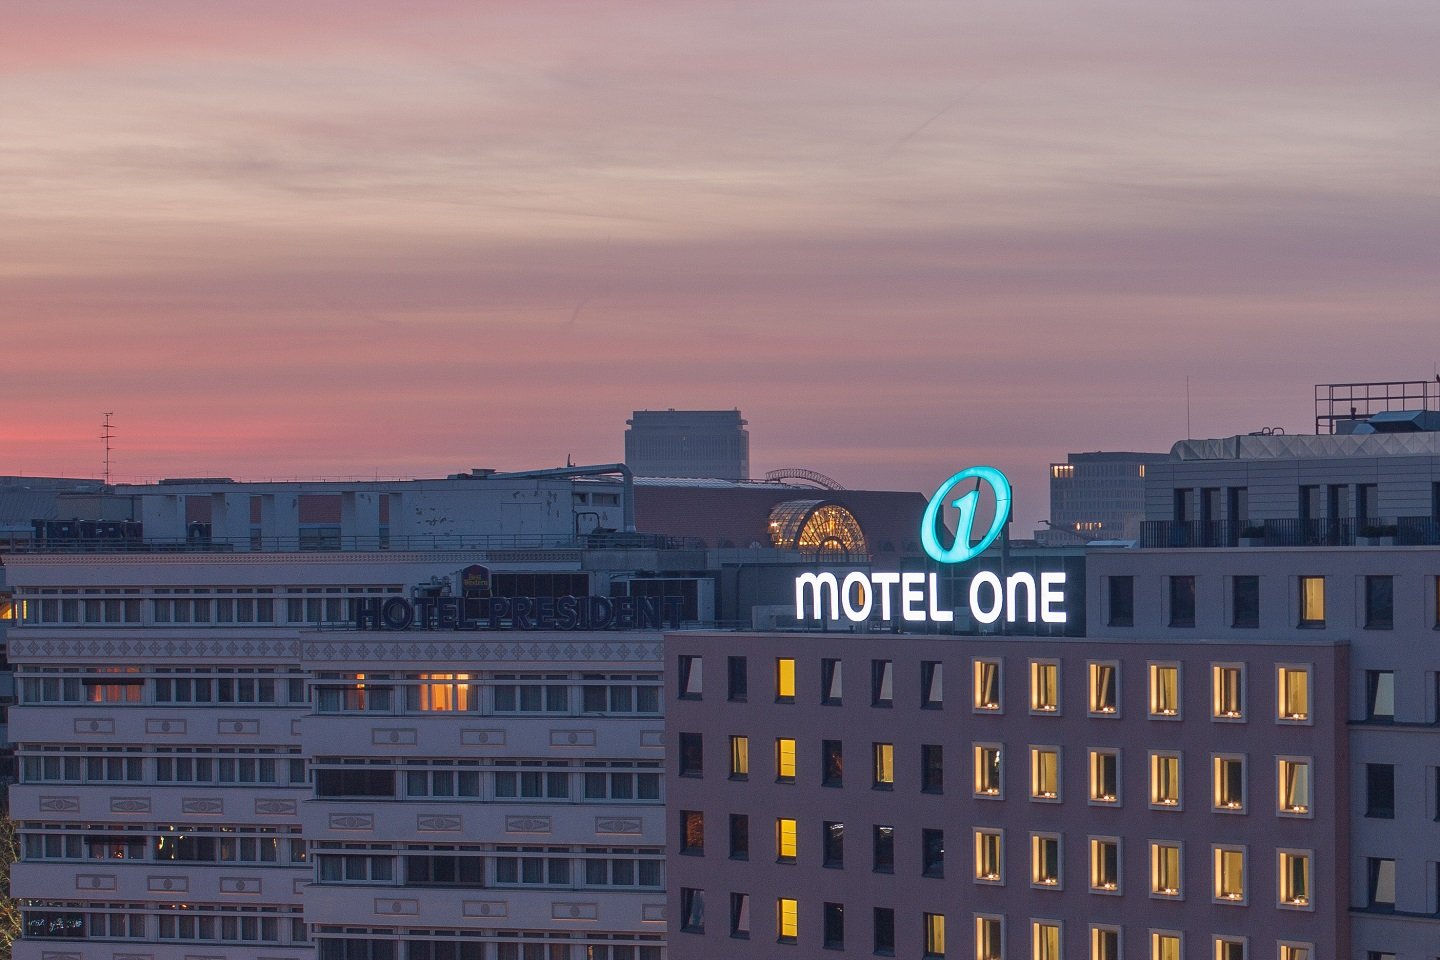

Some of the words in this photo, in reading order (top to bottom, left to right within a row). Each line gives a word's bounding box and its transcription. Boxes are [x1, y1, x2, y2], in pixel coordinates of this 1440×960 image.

[356, 595, 477, 631] HOTEL
[489, 595, 684, 631] PRESIDENT
[796, 571, 954, 622] MOTEL
[969, 571, 1067, 623] ONE
